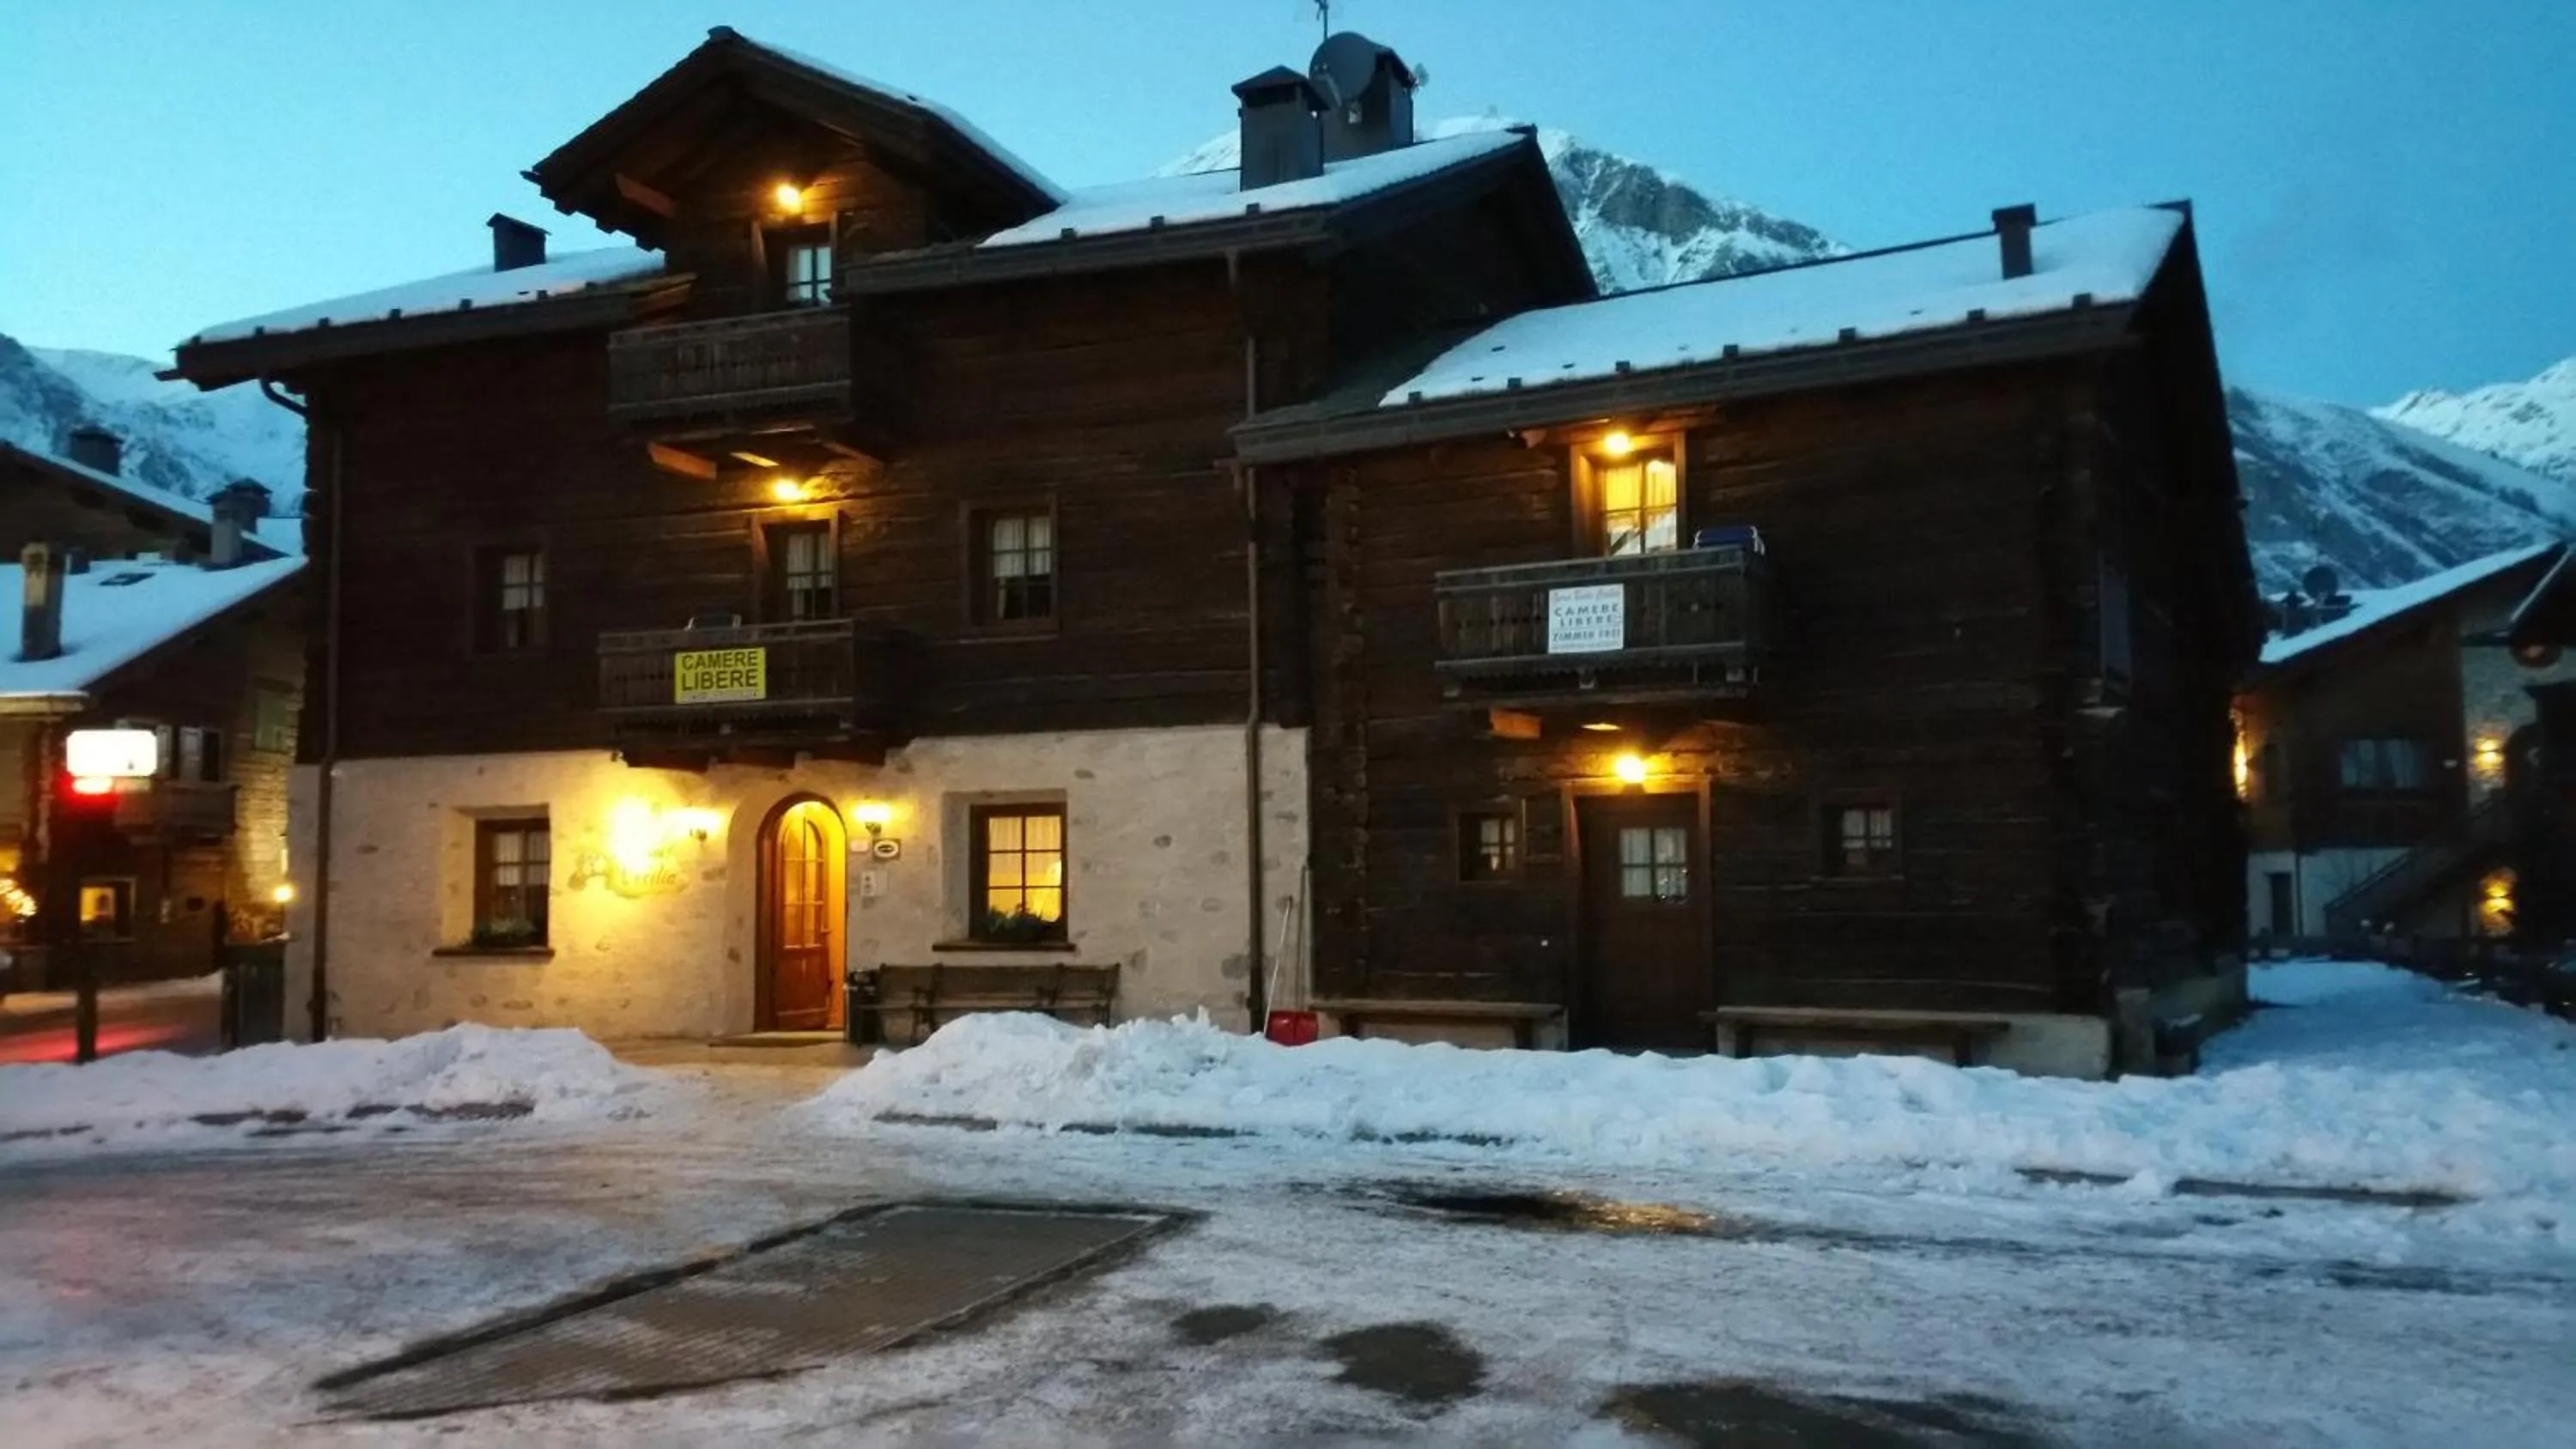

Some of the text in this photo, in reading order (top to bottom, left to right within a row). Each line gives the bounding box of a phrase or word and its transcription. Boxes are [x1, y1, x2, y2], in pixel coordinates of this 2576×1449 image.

[1553, 603, 1619, 617] CAMERE
[681, 651, 758, 670] CAMERE
[681, 669, 758, 691] LIBERE
